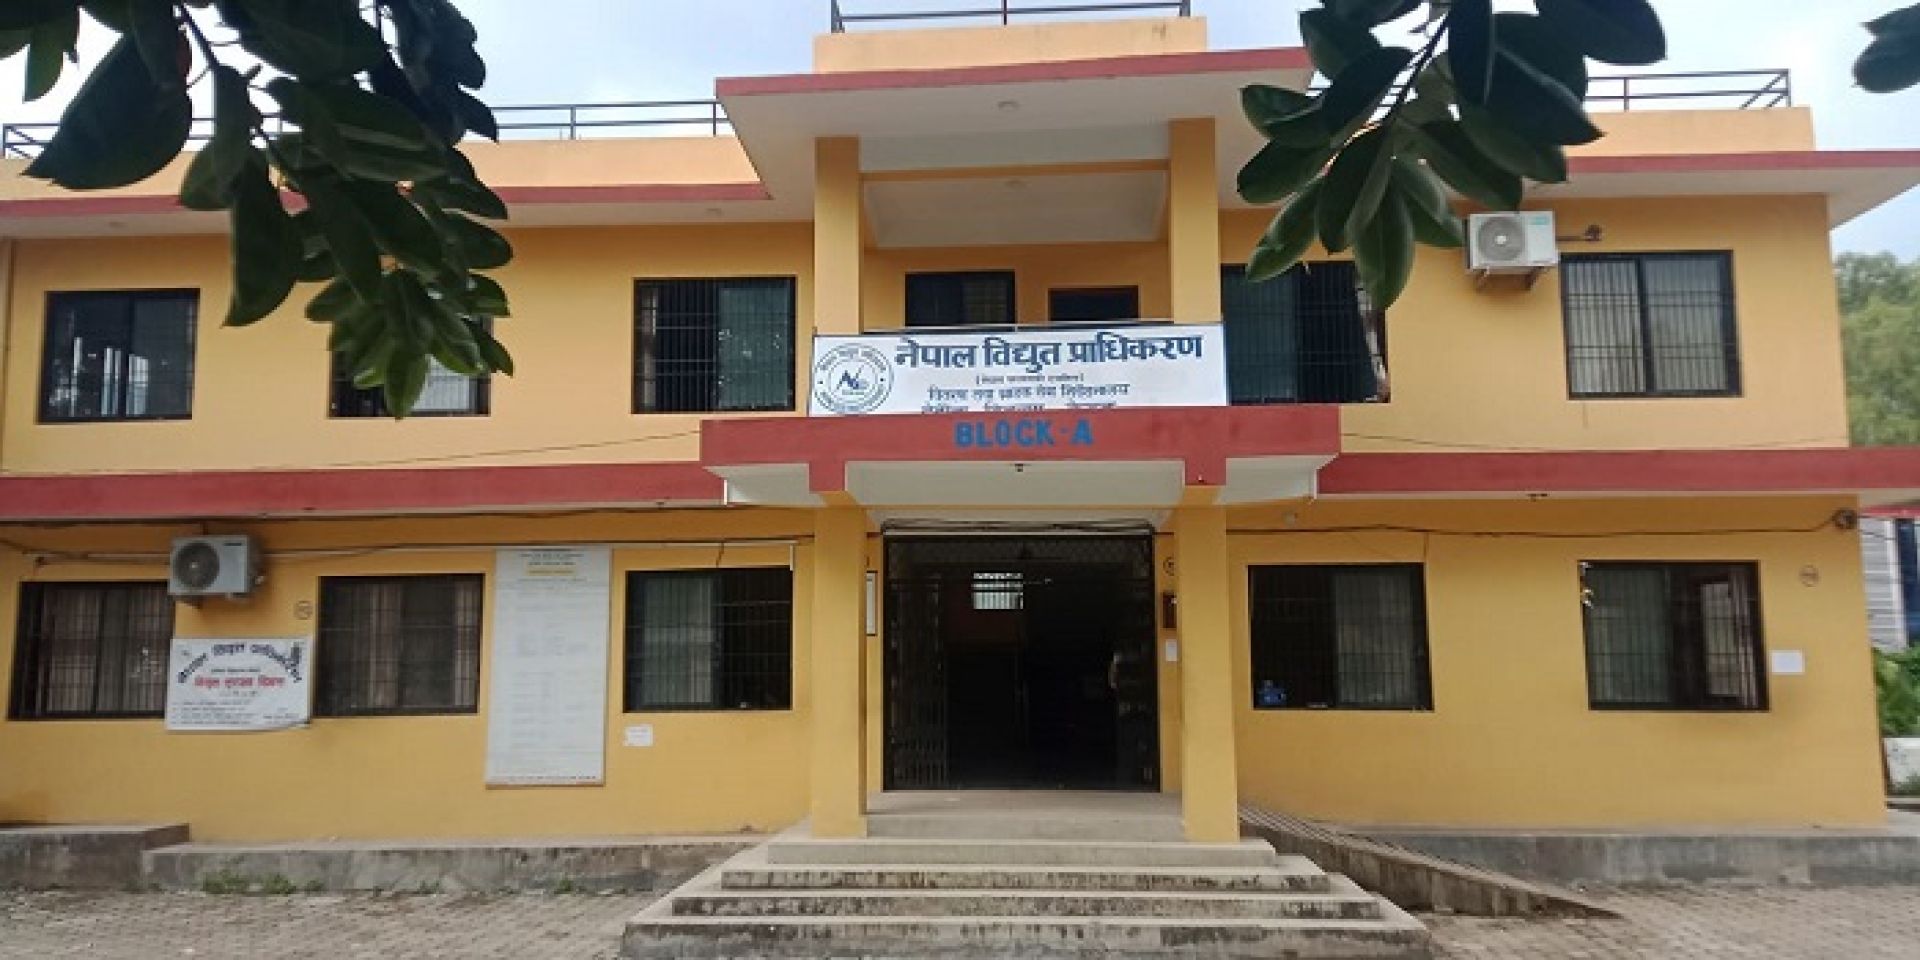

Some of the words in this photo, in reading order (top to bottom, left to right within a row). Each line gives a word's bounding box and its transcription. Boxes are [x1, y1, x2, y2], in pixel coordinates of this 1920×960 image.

[895, 336, 977, 367] नेपाल
[982, 336, 1062, 373] विद्युत
[1066, 332, 1202, 362] प्राधिकरण
